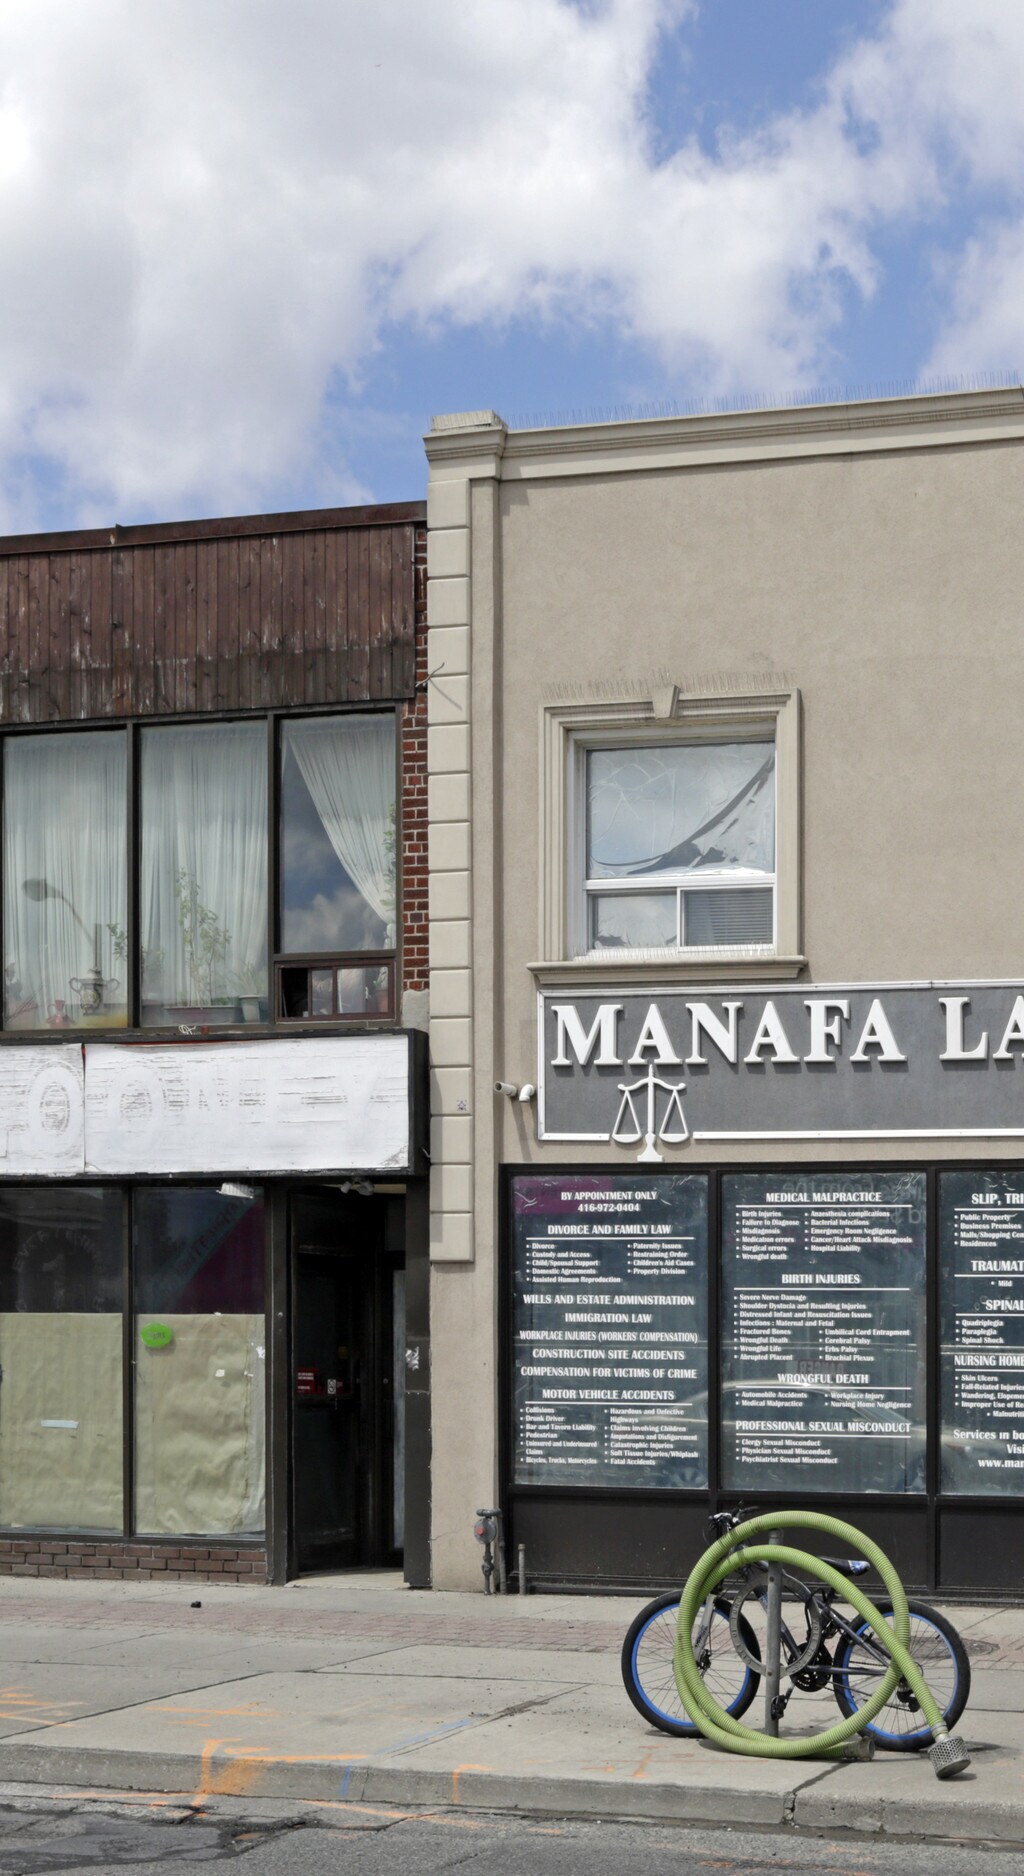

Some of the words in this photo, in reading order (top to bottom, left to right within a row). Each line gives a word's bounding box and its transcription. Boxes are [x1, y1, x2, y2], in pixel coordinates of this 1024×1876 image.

[551, 998, 908, 1066] MANAFA
[561, 1192, 572, 1200] BY
[574, 1191, 633, 1200] APPOINTMENT
[634, 1191, 657, 1200] ONLY
[766, 1192, 810, 1202] MEDICAL
[812, 1192, 882, 1202] MALPRACTICE
[971, 1193, 1001, 1205] SLIP,
[578, 1203, 640, 1212] 416-972-0404
[758, 1210, 782, 1218] Injuries
[771, 1219, 800, 1227] Diagnose
[548, 1225, 590, 1234] DIVORCE
[592, 1225, 613, 1234] AND
[614, 1224, 648, 1234] FAMILY
[651, 1225, 671, 1234] LAW
[633, 1251, 669, 1259] Restraining
[742, 1252, 769, 1261] Wrongful
[782, 1274, 813, 1284] BIRTH
[815, 1274, 861, 1284] INJURIES
[523, 1294, 552, 1304] WILLS
[554, 1295, 574, 1304] AND
[576, 1295, 611, 1304] ESTATE
[613, 1295, 695, 1305] ADMINISTRATION
[565, 1313, 629, 1323] IMMIGRATION
[632, 1314, 652, 1323] LAW
[520, 1330, 564, 1340] WORKPLACE
[564, 1331, 597, 1341] INJURIES
[598, 1331, 638, 1341] (WORKERS'
[639, 1332, 698, 1343] COMPENSATION)
[962, 1328, 997, 1336] Paraplegia
[853, 1337, 871, 1345] Palsy
[532, 1348, 605, 1359] CONSTRUCTION
[608, 1350, 629, 1359] SITE
[631, 1350, 685, 1360] ACCIDENTS
[954, 1354, 996, 1366] NURSING
[521, 1366, 590, 1377] COMPENSATION
[593, 1367, 611, 1377] FOR
[613, 1368, 650, 1378] VICTIMS
[652, 1368, 665, 1378] OF
[667, 1369, 697, 1379] CRIME
[776, 1373, 833, 1385] WRONGFUL
[836, 1374, 869, 1384] DEATH
[542, 1389, 576, 1399] MOTOR
[579, 1390, 619, 1399] VEHICLE
[621, 1390, 675, 1400] ACCIDENTS
[610, 1416, 639, 1424] Highways
[632, 1425, 659, 1433] involving
[735, 1420, 807, 1431] PROFESSIONAL
[808, 1422, 845, 1432] SEXUAL
[848, 1422, 911, 1432] MISCONDUCT
[952, 1429, 996, 1441] Services
[999, 1432, 1010, 1440] in
[610, 1441, 648, 1449] Catastrophic
[650, 1440, 674, 1449] Injuries
[626, 1457, 656, 1465] Accidents
